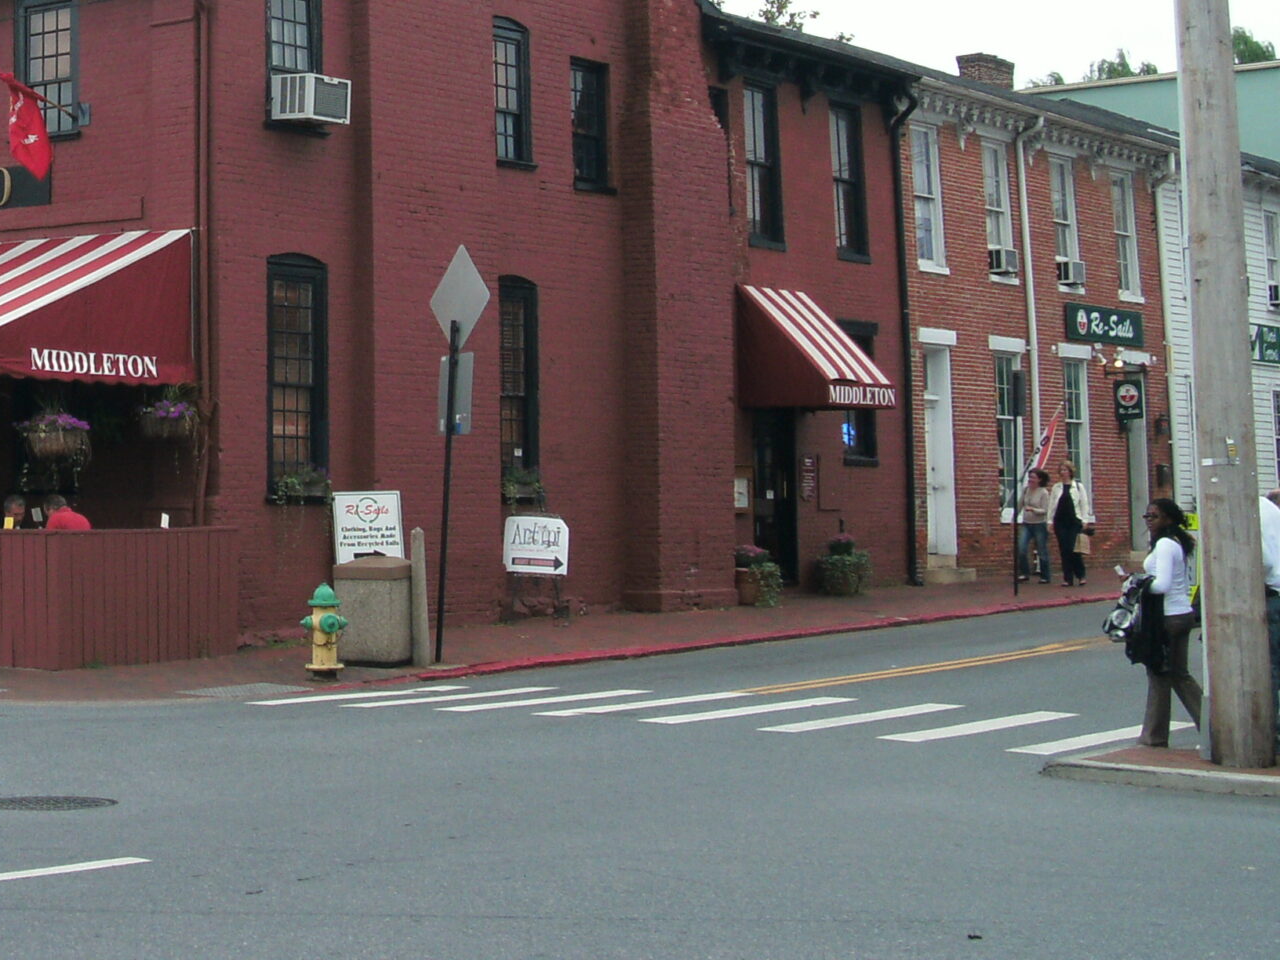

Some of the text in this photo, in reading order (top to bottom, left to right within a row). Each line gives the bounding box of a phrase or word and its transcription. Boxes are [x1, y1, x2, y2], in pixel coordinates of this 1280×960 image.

[1090, 311, 1135, 339] Re-Sails
[30, 347, 158, 378] MIDDLETON
[828, 384, 896, 406] MIDDLETON
